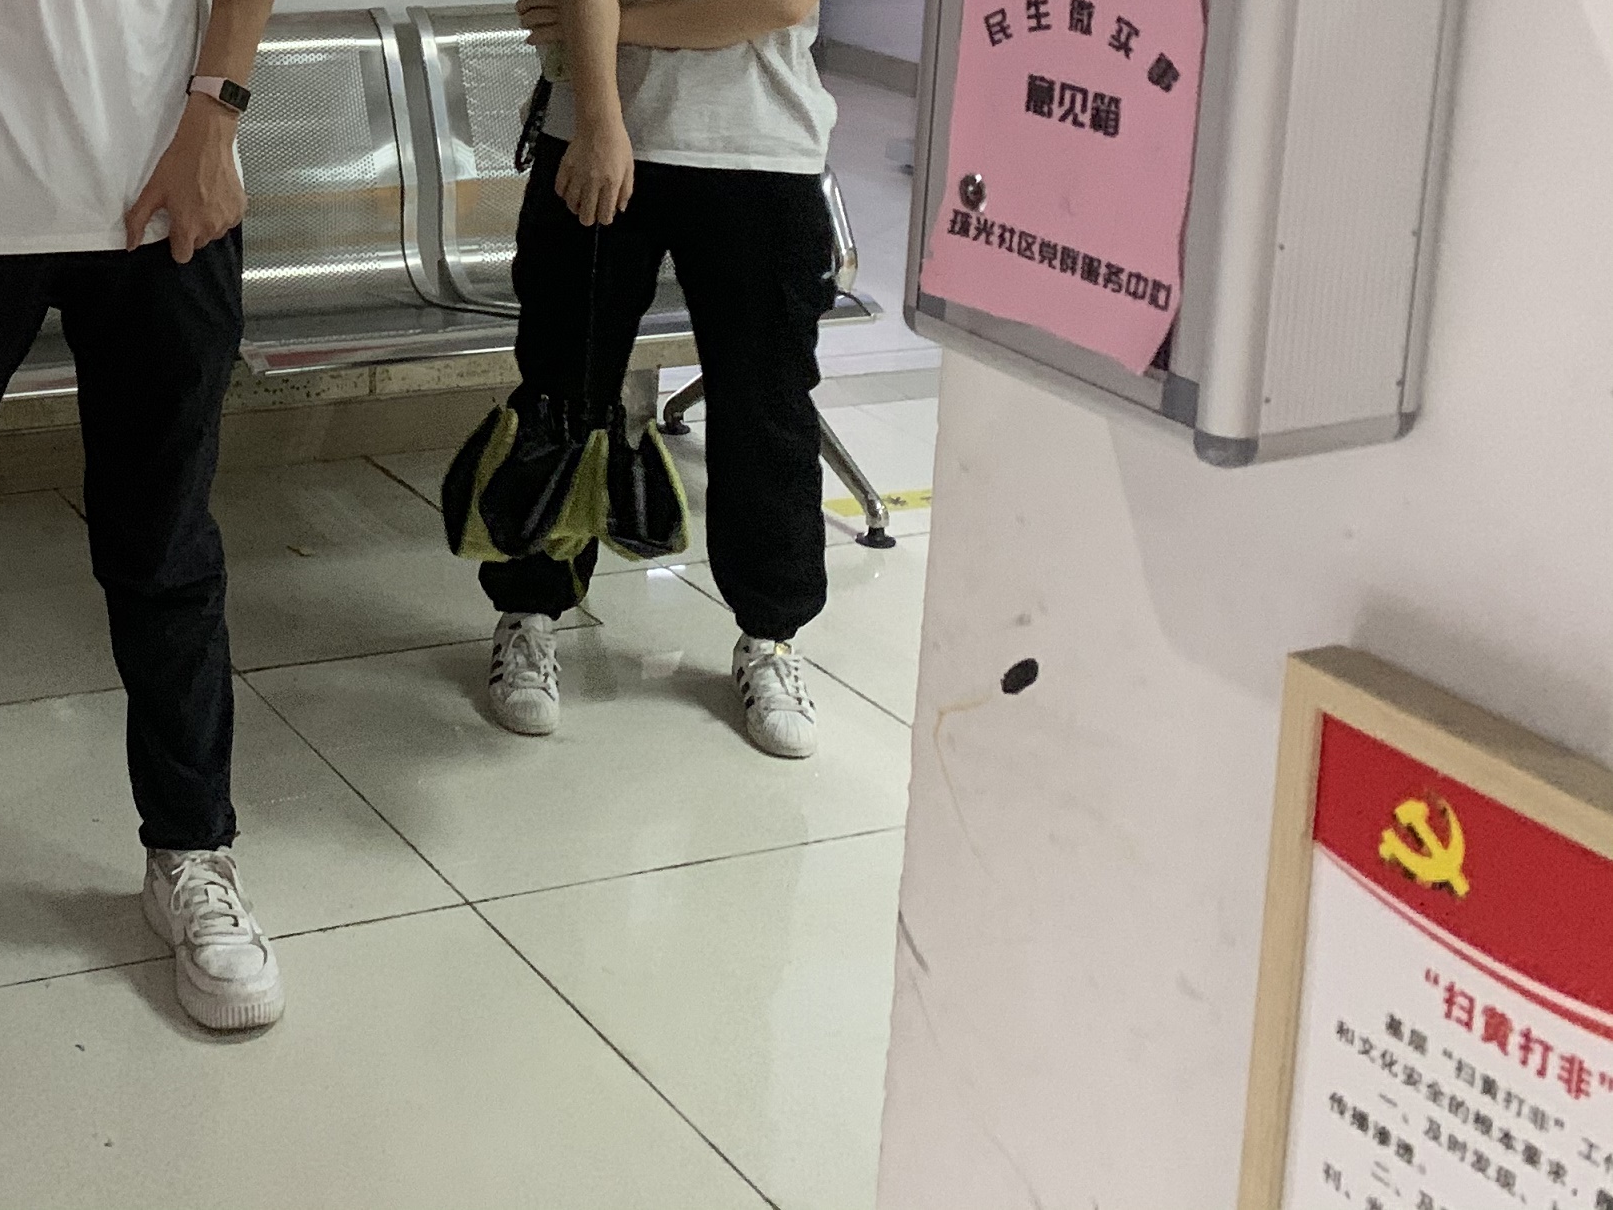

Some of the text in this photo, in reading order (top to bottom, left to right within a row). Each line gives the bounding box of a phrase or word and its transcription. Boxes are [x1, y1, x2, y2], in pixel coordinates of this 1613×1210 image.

[1025, 73, 1122, 138] 意见箱
[947, 208, 1173, 313] 珠光社区党群服务中心
